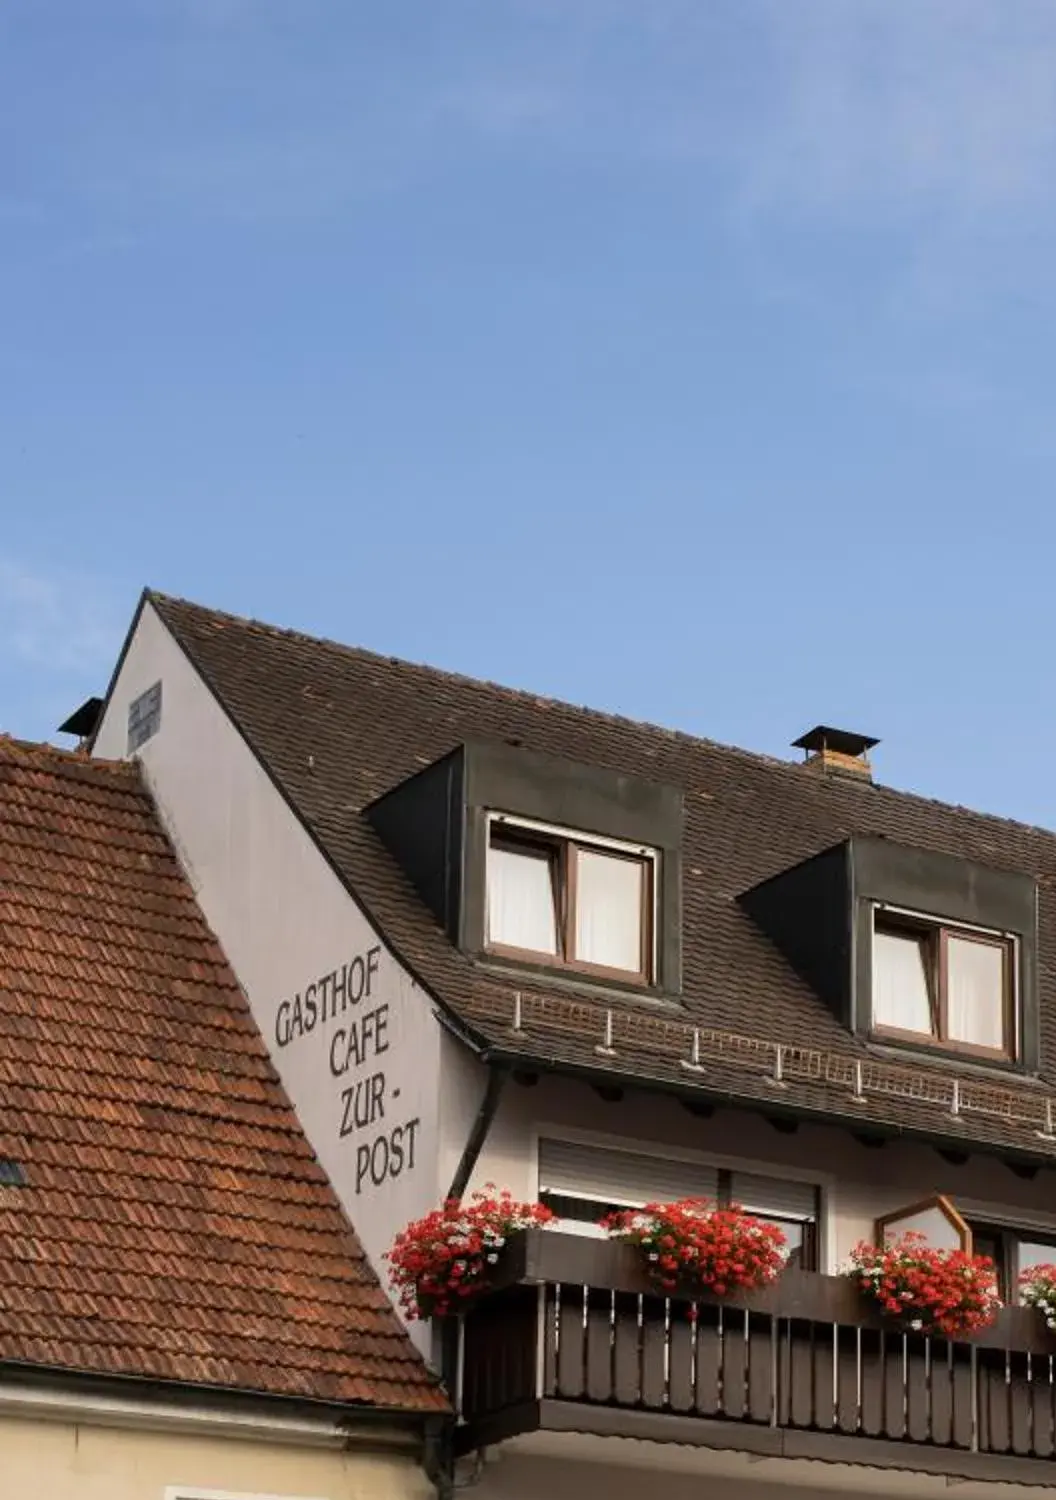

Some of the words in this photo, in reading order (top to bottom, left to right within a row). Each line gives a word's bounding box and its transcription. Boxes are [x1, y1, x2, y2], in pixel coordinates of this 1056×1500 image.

[274, 945, 382, 1048] GASTHOF
[329, 1003, 390, 1077] CAFE
[339, 1071, 386, 1138] ZUR
[355, 1117, 421, 1195] POST
